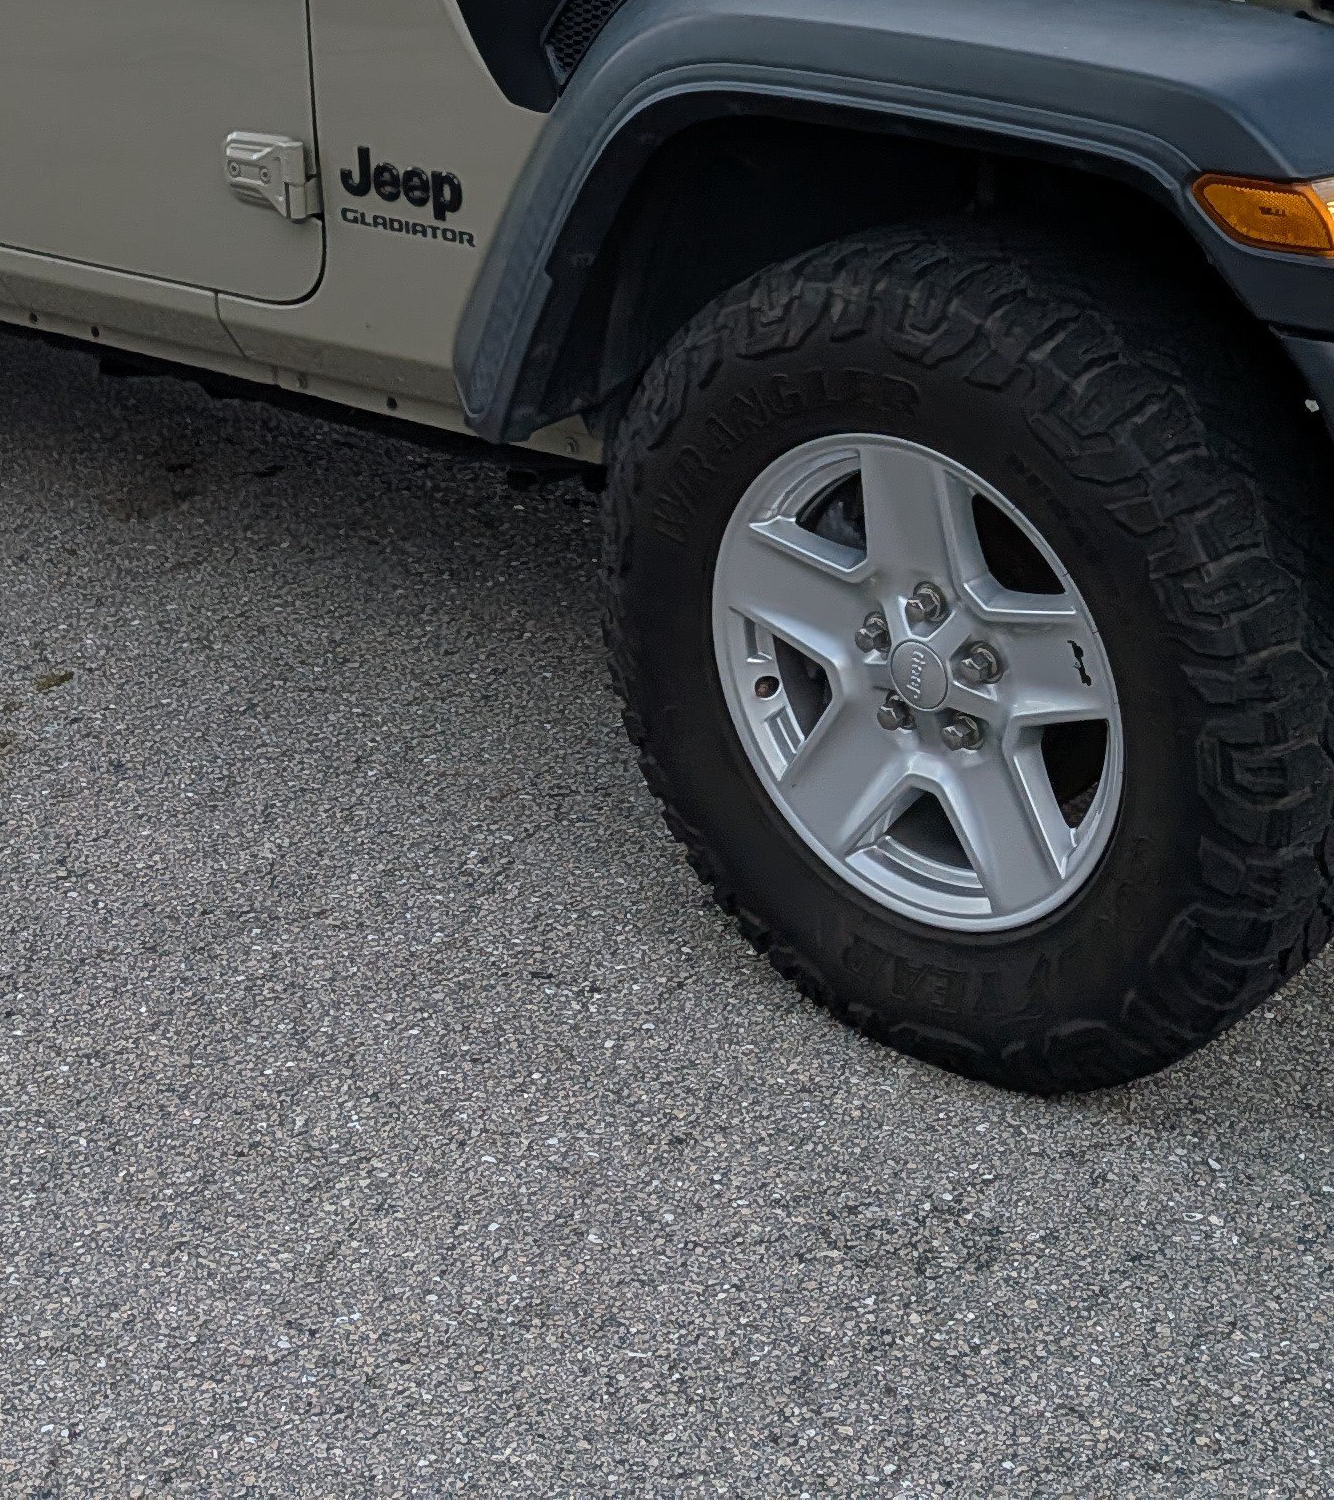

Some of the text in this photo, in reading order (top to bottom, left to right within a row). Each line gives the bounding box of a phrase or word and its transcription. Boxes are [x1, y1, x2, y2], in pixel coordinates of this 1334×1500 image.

[340, 145, 463, 222] Jeep
[340, 206, 476, 248] GLADIATOR
[652, 367, 922, 544] WRANGLER
[906, 650, 927, 699] Jeep
